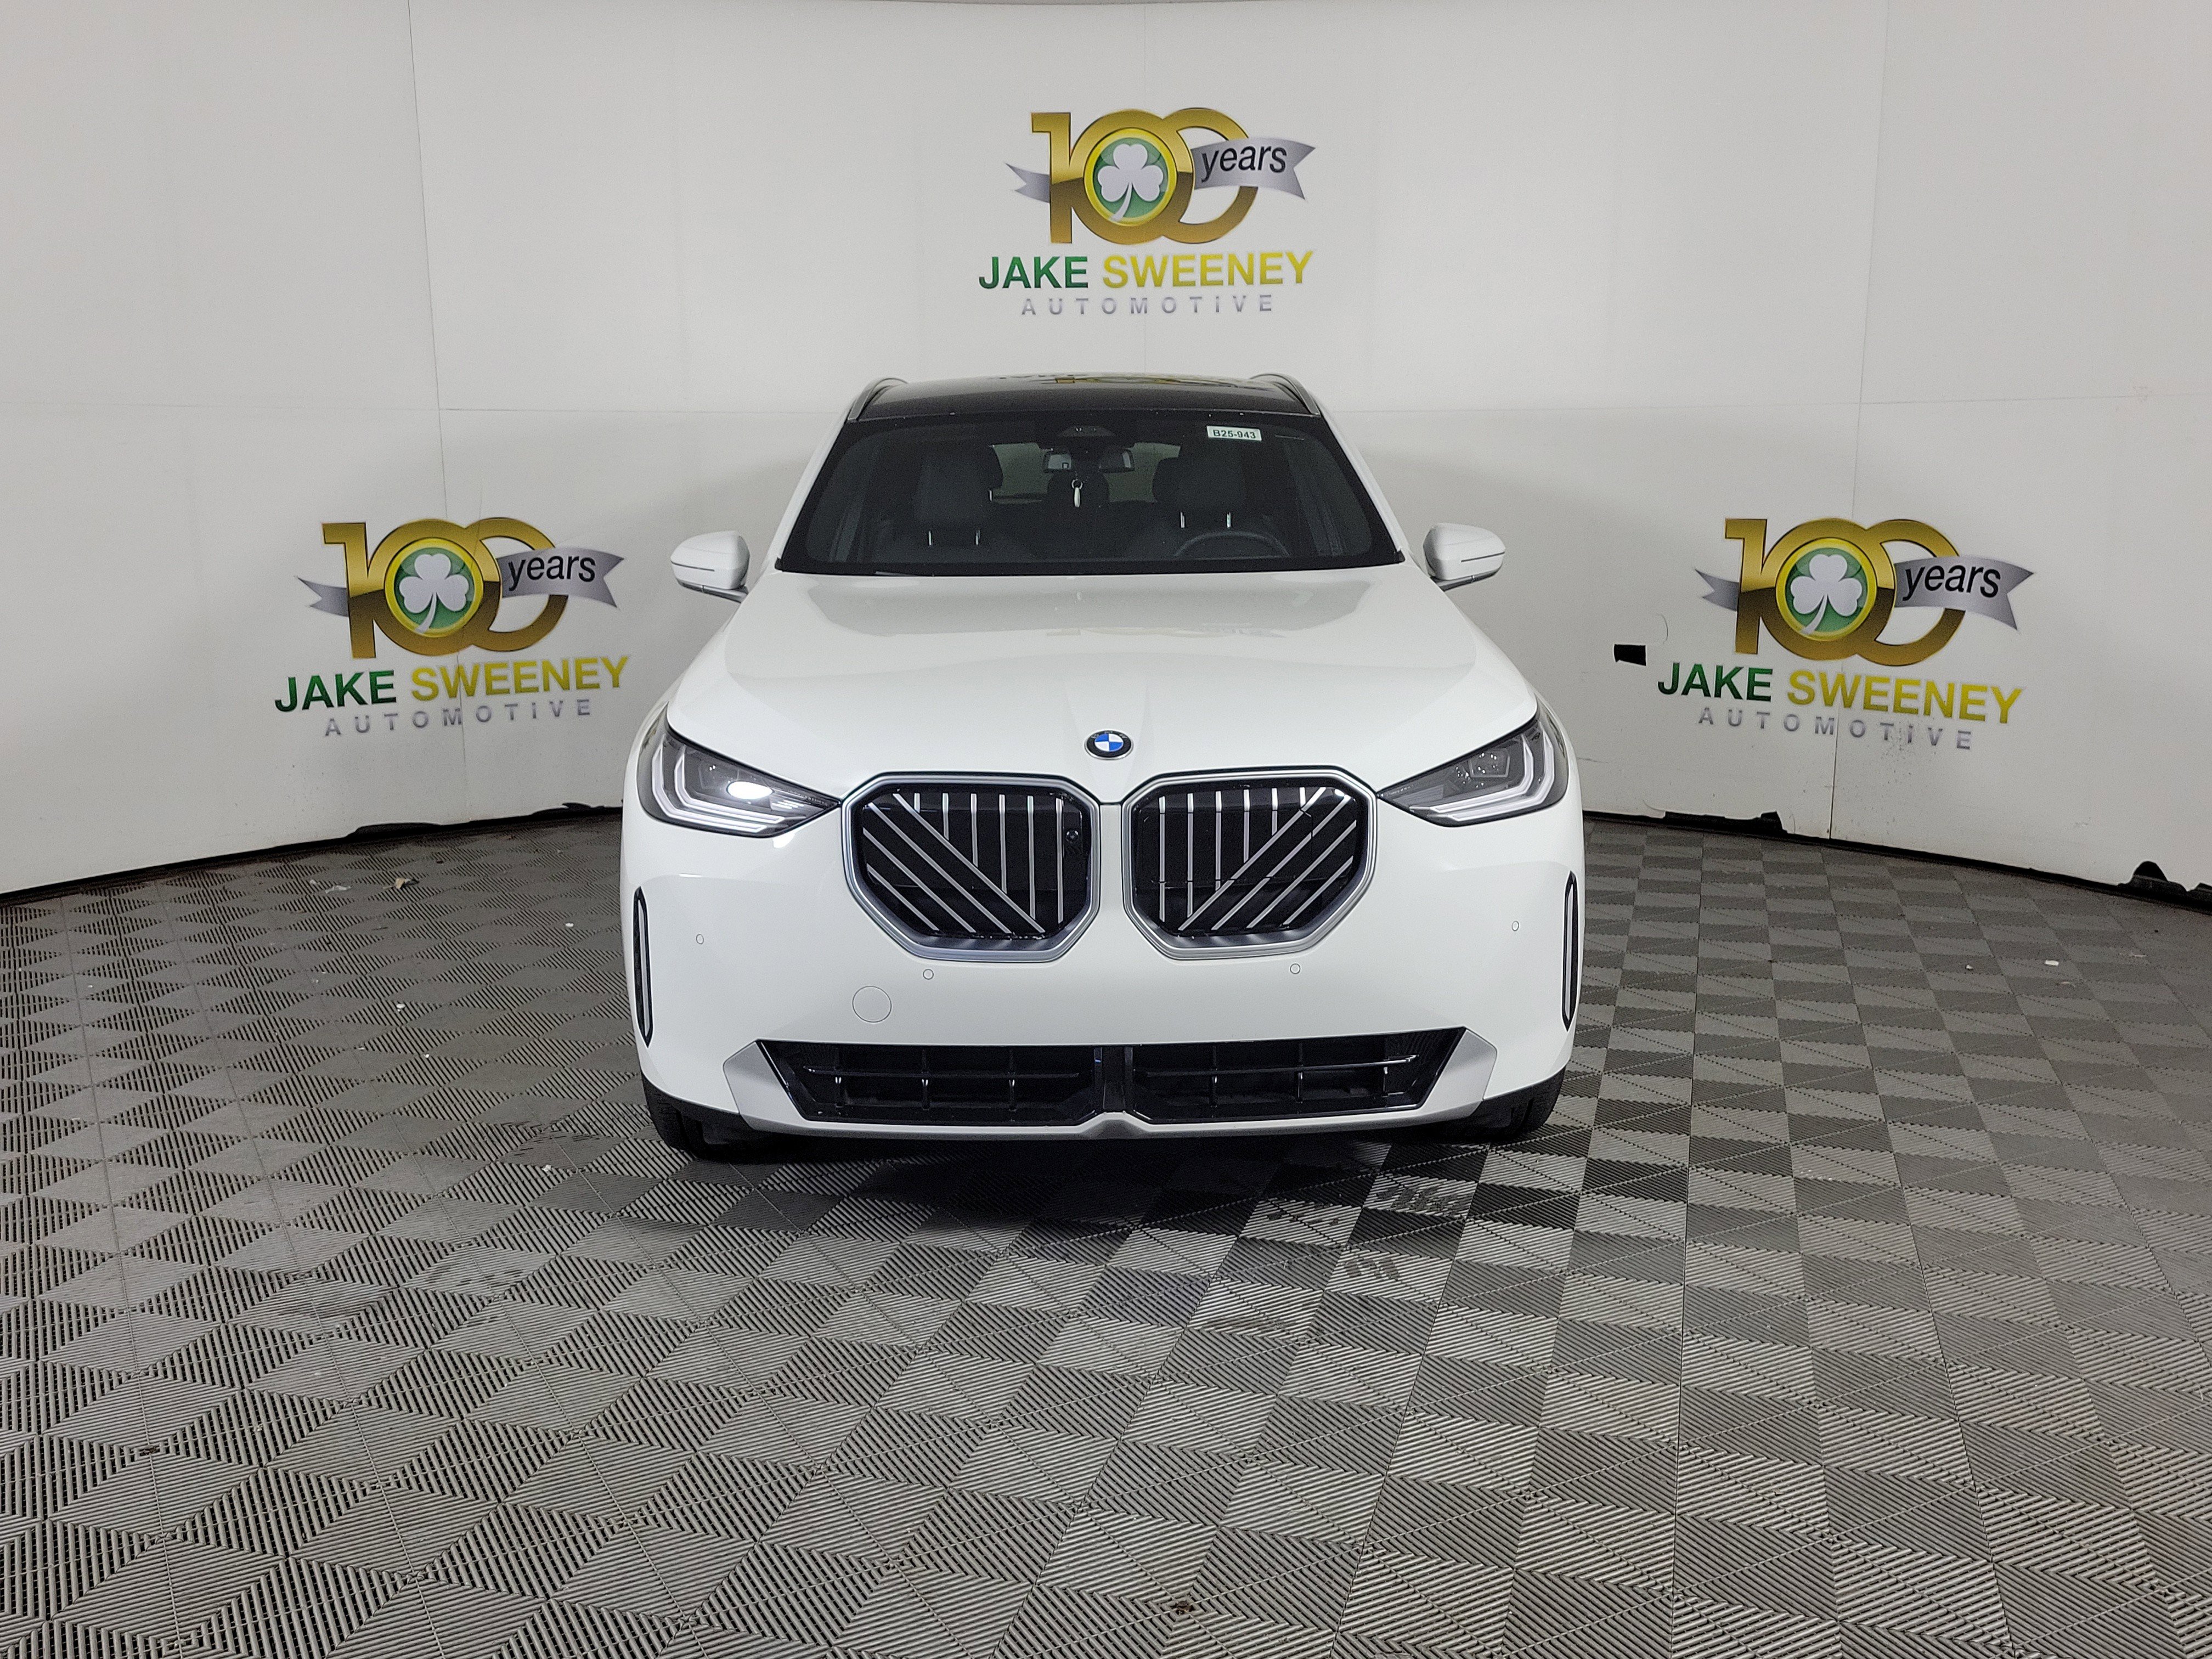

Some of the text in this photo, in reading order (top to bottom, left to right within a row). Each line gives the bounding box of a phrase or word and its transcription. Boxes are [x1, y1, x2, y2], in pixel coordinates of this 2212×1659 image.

[1031, 108, 1288, 245] 100 years
[979, 250, 1314, 290] JAKE SWEENEY
[1021, 294, 1273, 315] AUTOMOTIVE
[1212, 429, 1256, 439] B25-943
[321, 517, 596, 659] 100 years
[1725, 517, 2001, 667] 100 years
[274, 656, 629, 712] JAKE SWEENEY
[1657, 662, 2023, 724] JAKE SWEENEY
[325, 699, 590, 736] AUTOMOTIVE
[1698, 707, 1972, 750] AUTOMOTIVE
